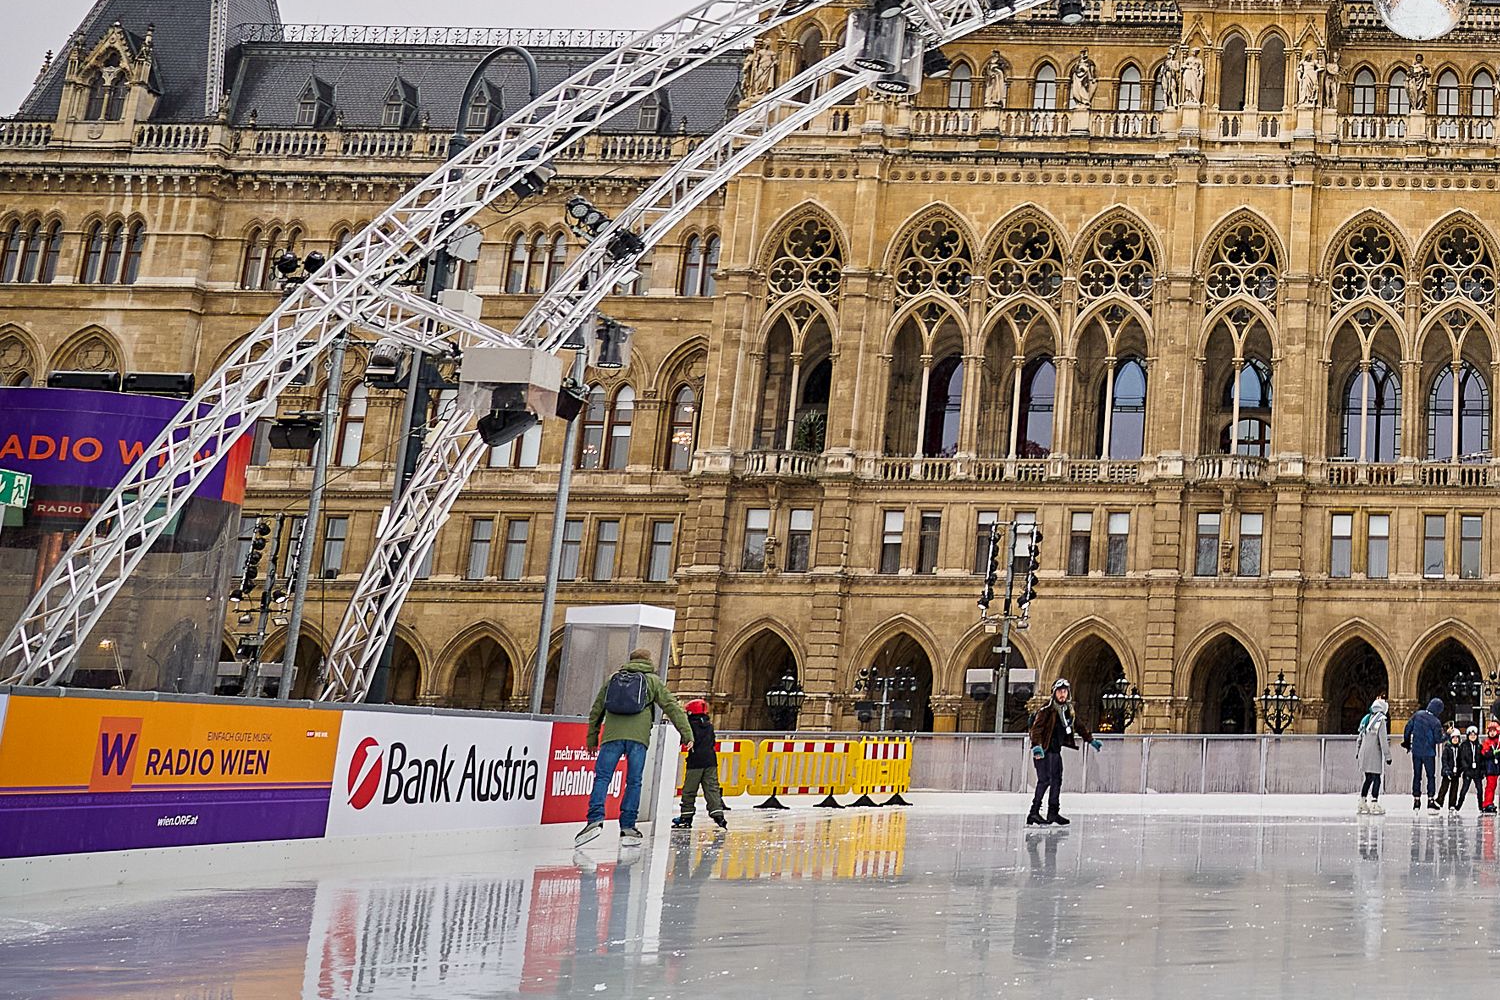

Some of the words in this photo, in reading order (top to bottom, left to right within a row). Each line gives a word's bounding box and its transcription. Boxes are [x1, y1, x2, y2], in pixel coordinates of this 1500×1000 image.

[37, 504, 83, 514] RADIO
[234, 732, 252, 742] GUTE
[101, 732, 137, 776] W
[145, 748, 215, 776] RADIO
[221, 749, 270, 776] WIEN
[554, 745, 573, 760] mehr
[382, 742, 455, 805] Bank
[456, 744, 539, 802] Austria
